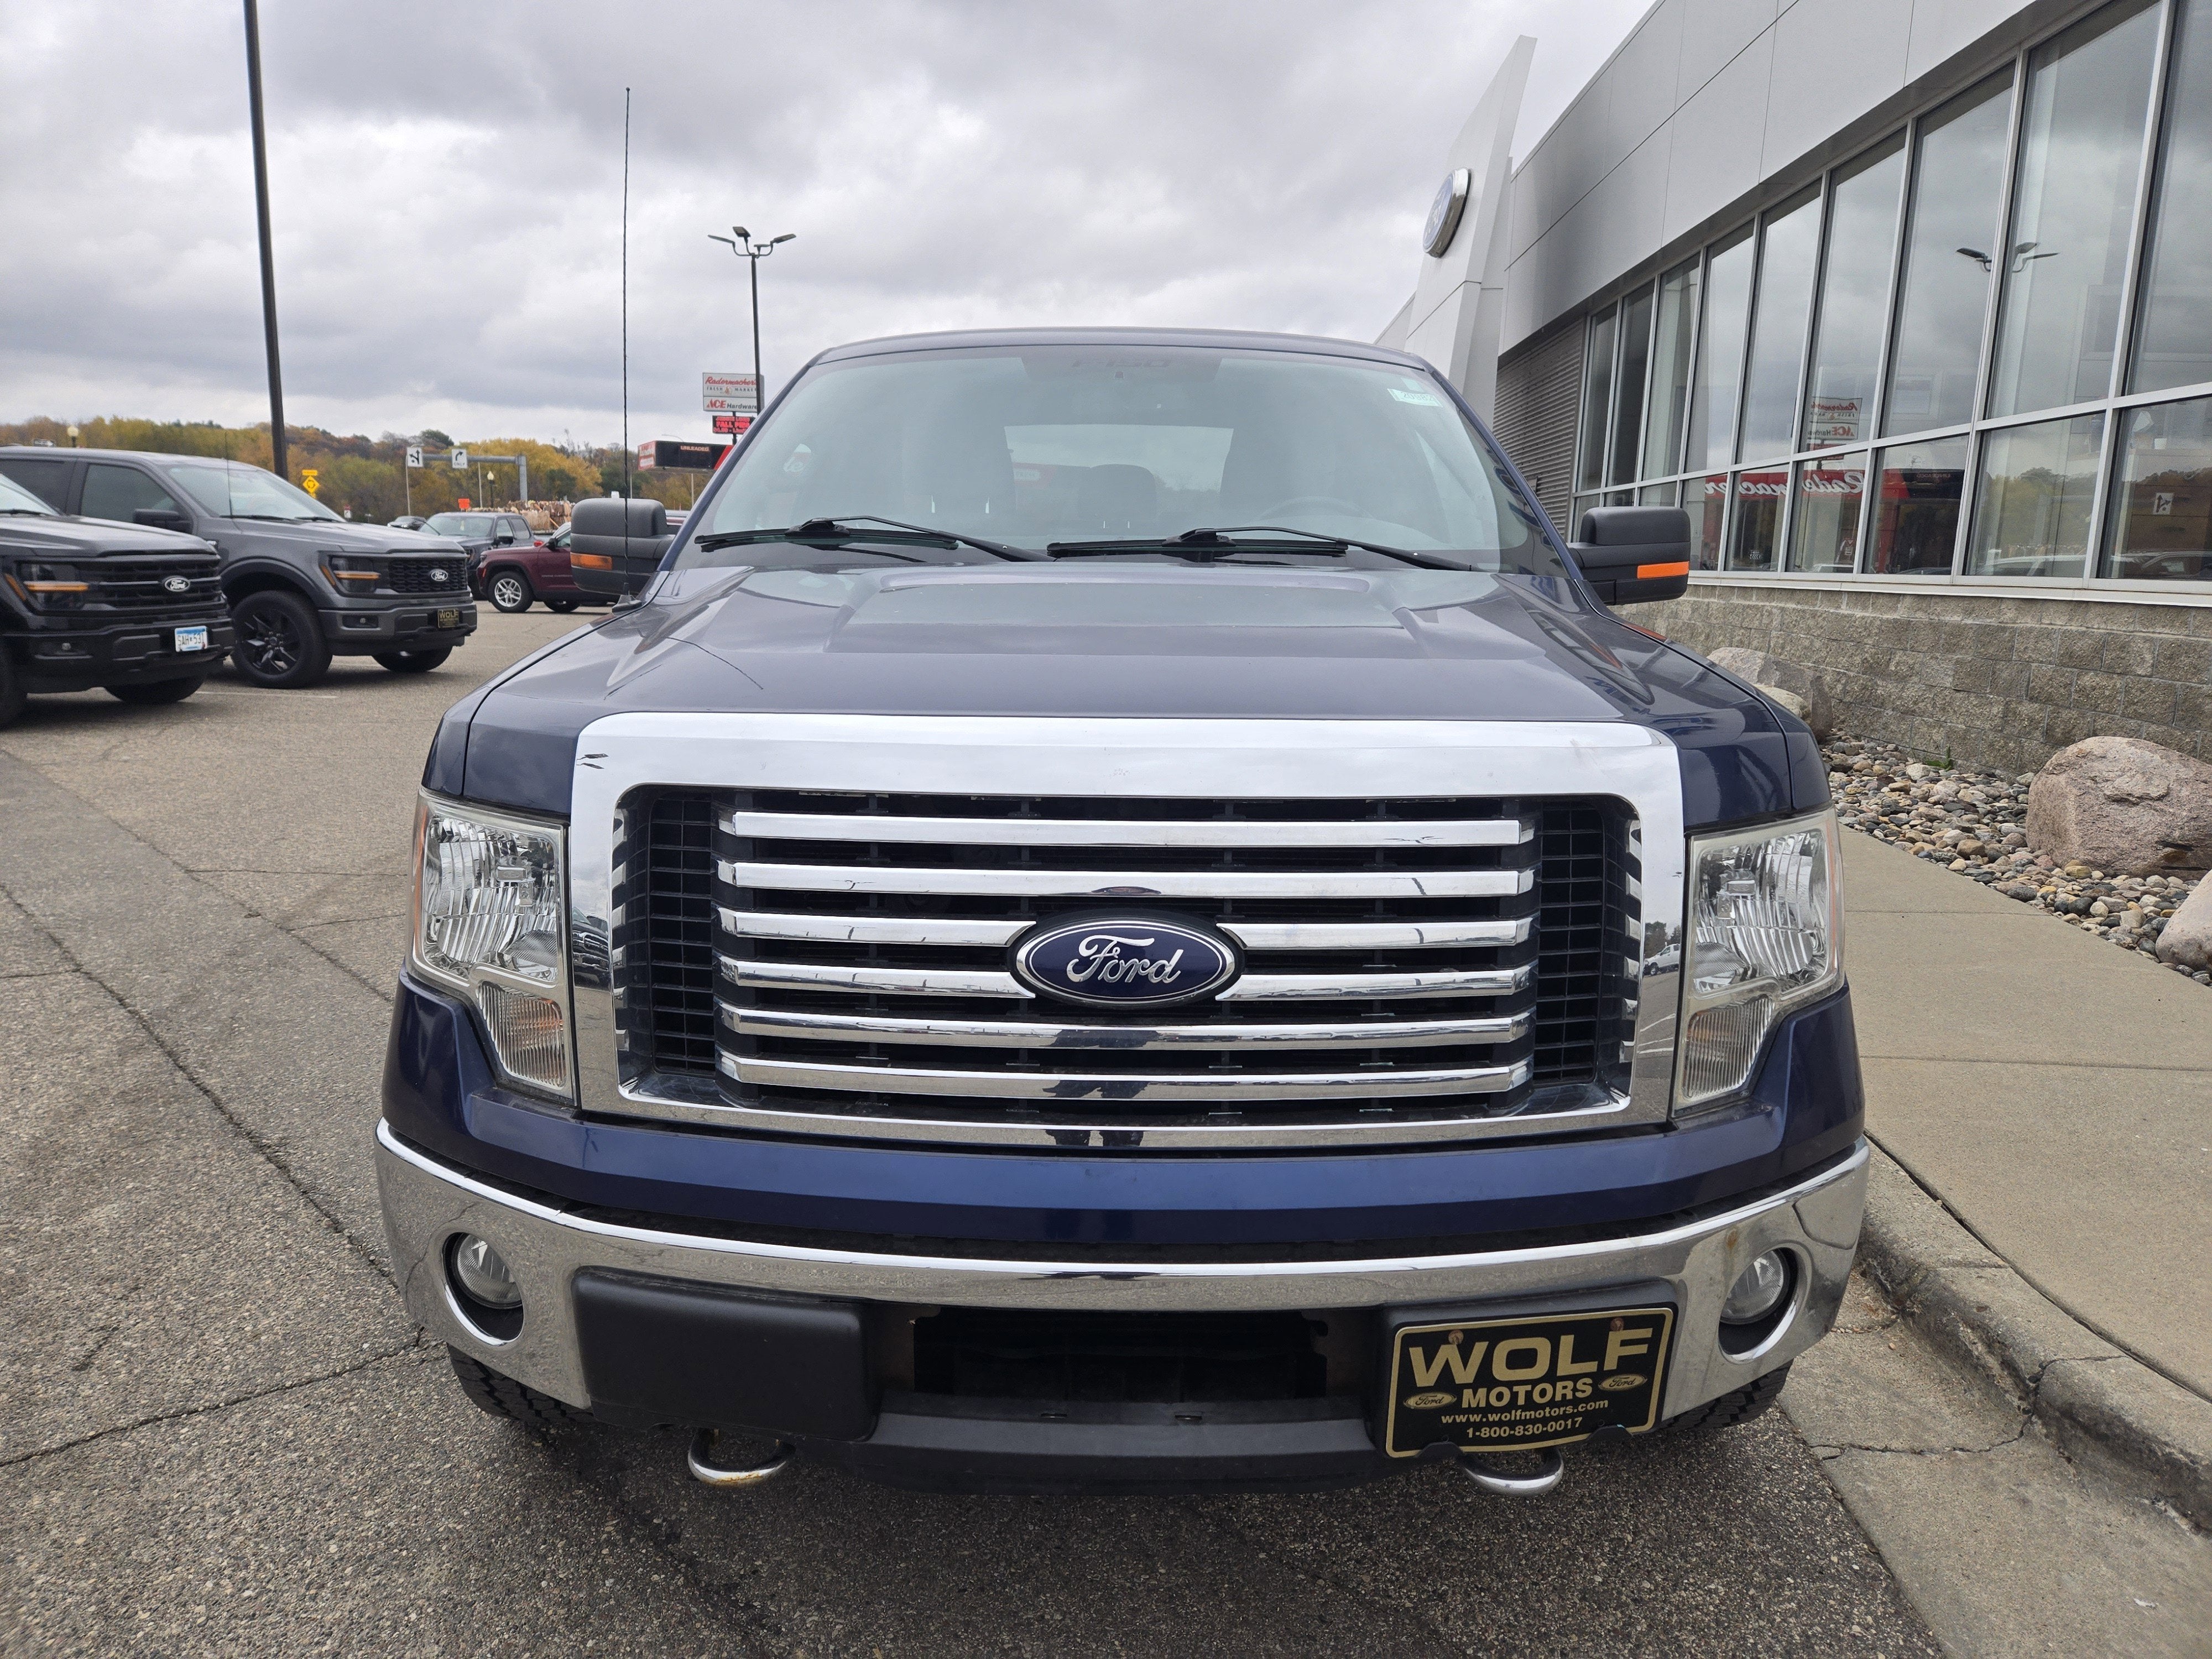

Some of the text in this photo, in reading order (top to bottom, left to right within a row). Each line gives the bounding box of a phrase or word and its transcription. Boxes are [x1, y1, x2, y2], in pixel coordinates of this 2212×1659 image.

[706, 399, 727, 408] ACE
[1066, 935, 1184, 983] Ford
[1408, 1327, 1653, 1387] WOLF
[1461, 1378, 1594, 1408] MOTORS
[1441, 1399, 1609, 1425] www.wolfmotors.com
[1467, 1417, 1583, 1438] 1-800-830-0017
